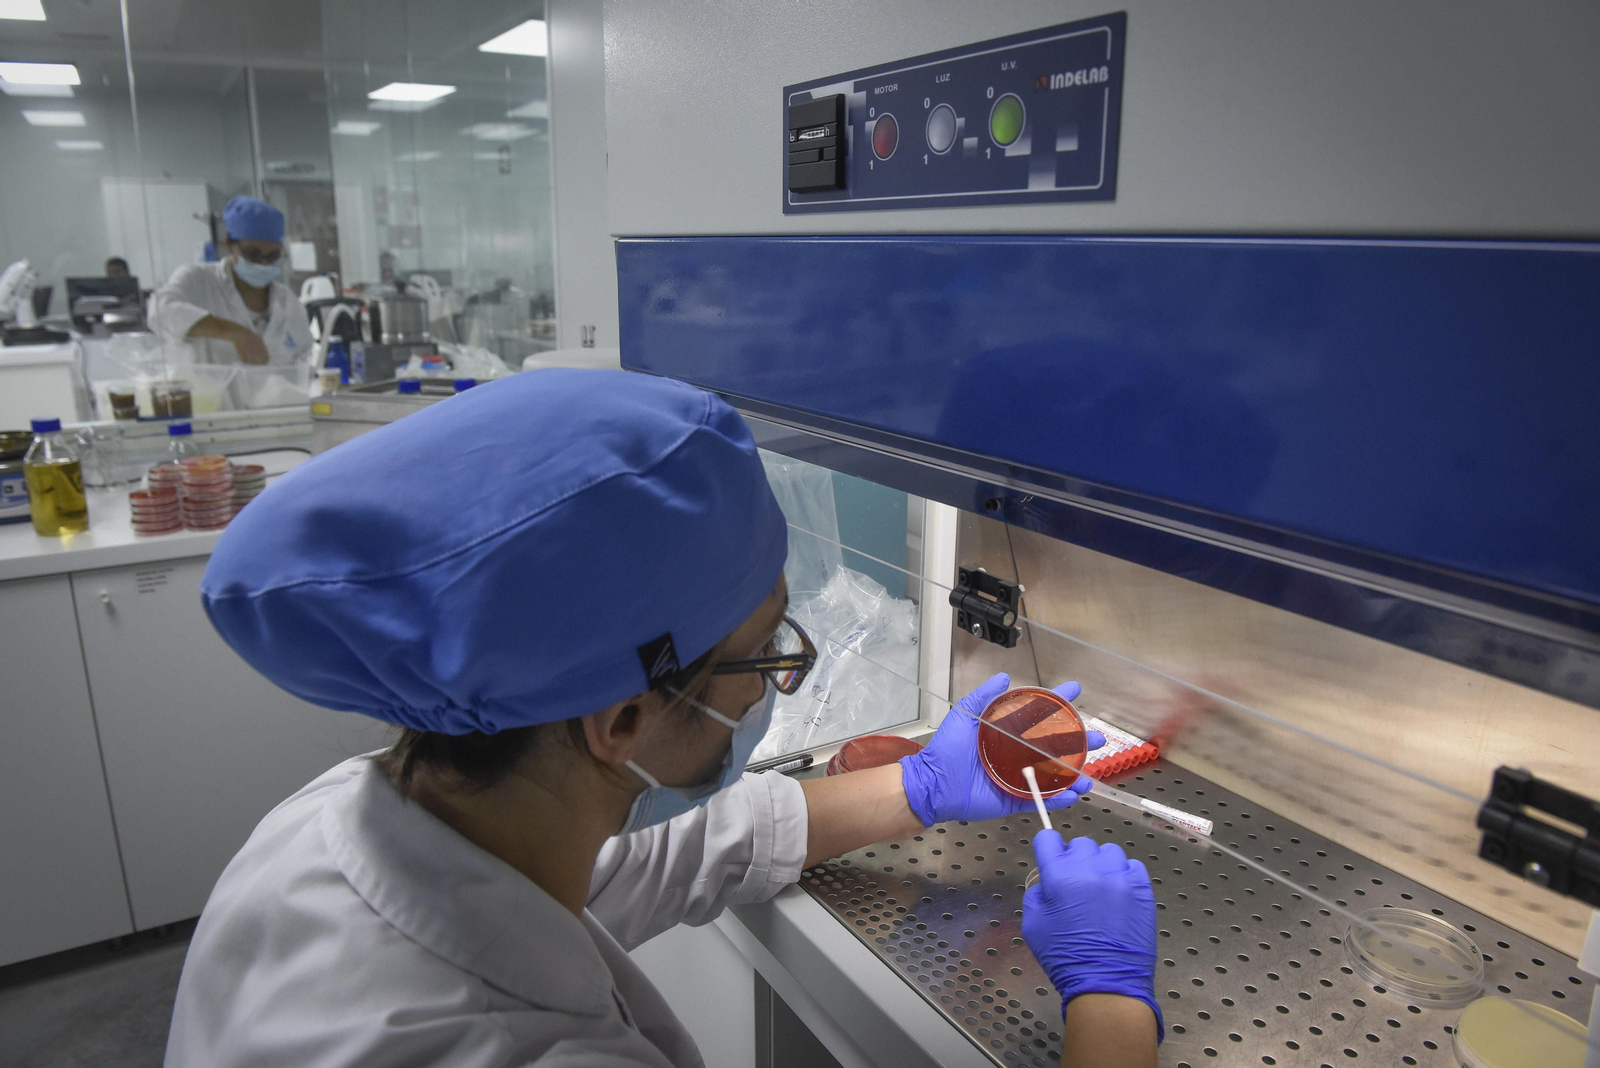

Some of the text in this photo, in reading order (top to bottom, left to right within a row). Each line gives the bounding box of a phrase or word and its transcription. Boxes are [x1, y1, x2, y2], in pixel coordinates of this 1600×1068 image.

[935, 73, 951, 83] LUZ
[1050, 65, 1109, 90] INDELAB
[874, 83, 899, 95] MOTOR
[986, 86, 994, 99] 0
[923, 97, 930, 109] 0
[869, 107, 875, 118] 0
[985, 147, 991, 159] 1
[869, 160, 874, 170] 1
[923, 154, 928, 165] 1
